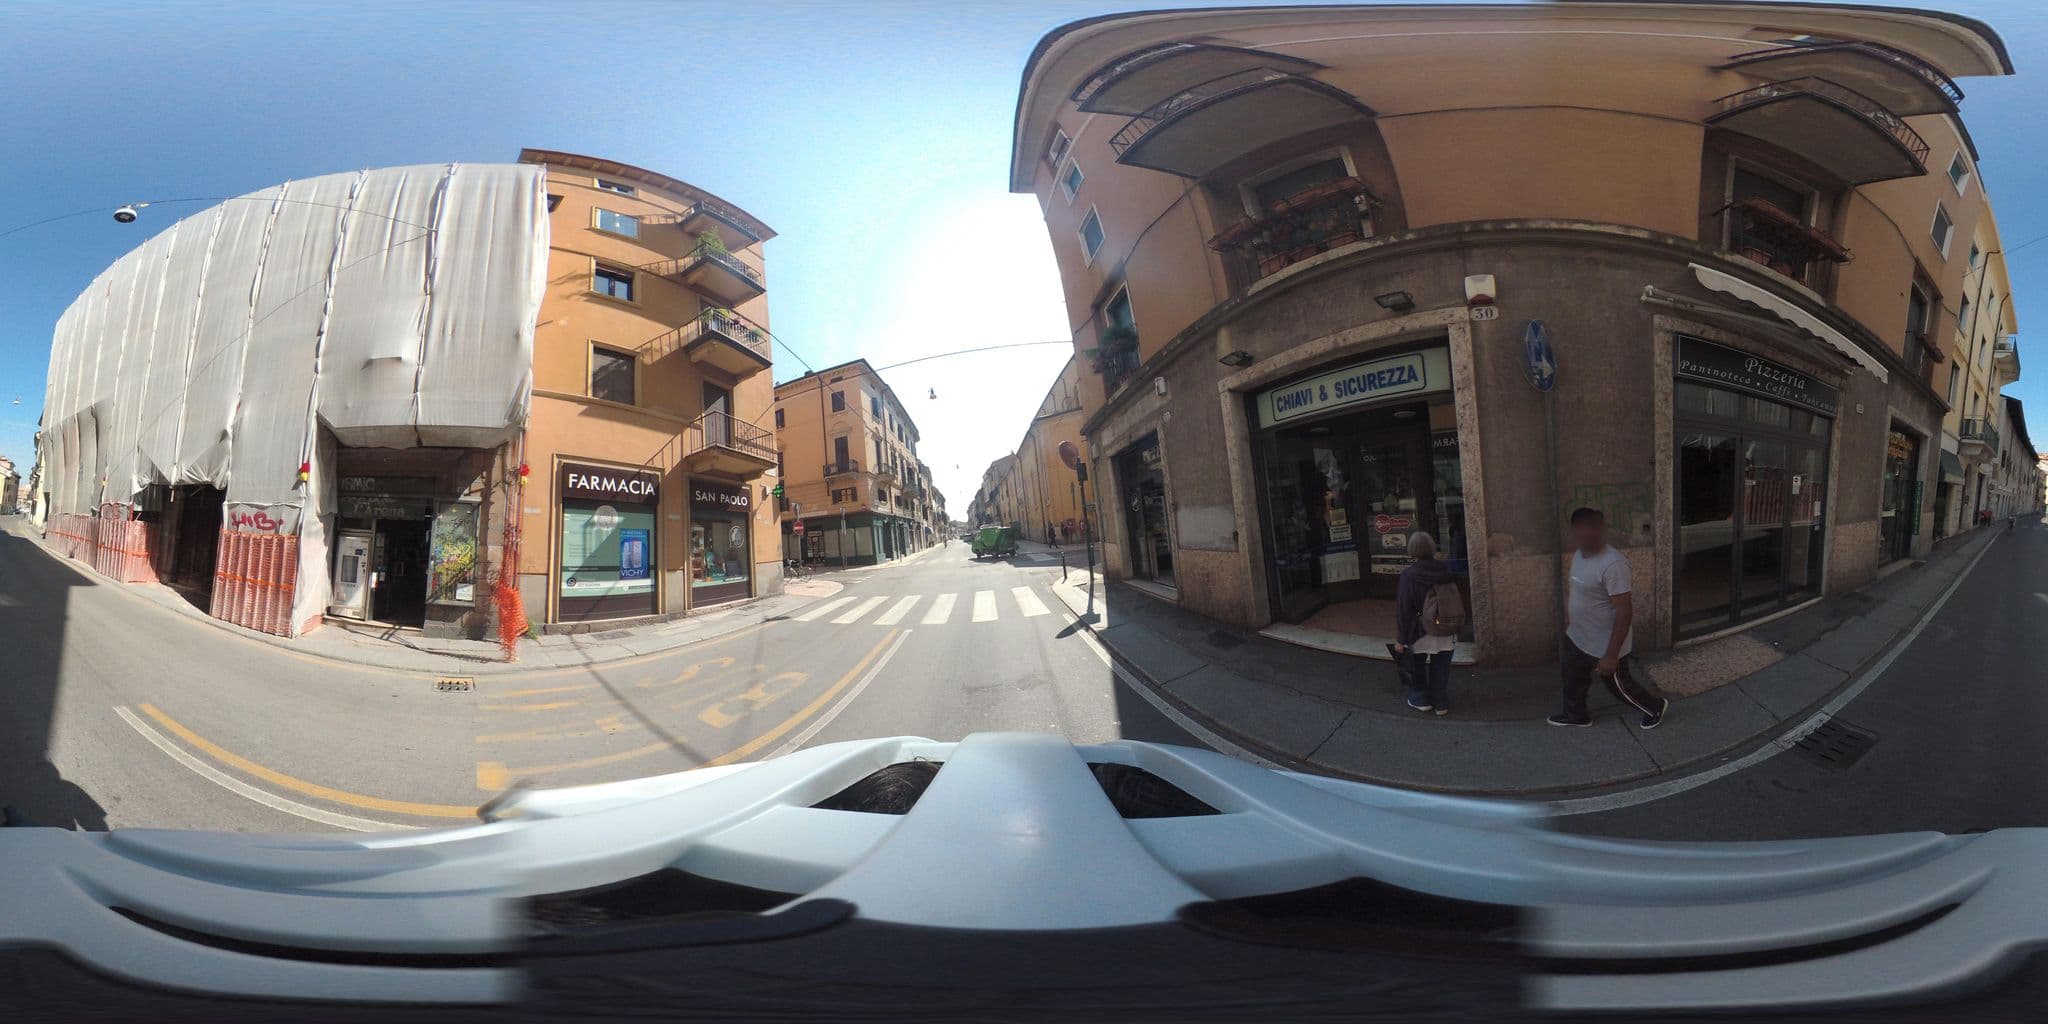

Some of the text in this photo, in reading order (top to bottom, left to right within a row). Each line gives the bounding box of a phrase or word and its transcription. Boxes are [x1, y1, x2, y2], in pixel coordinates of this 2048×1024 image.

[1474, 307, 1493, 319] 30
[1679, 360, 1751, 384] Paninoteca
[1744, 357, 1806, 390] Pizzeria
[1276, 364, 1418, 413] CHIAVI & SICUREZZA
[568, 473, 655, 496] FARMACIA
[695, 490, 748, 506] SAN PAOLO
[620, 569, 645, 577] VICHY
